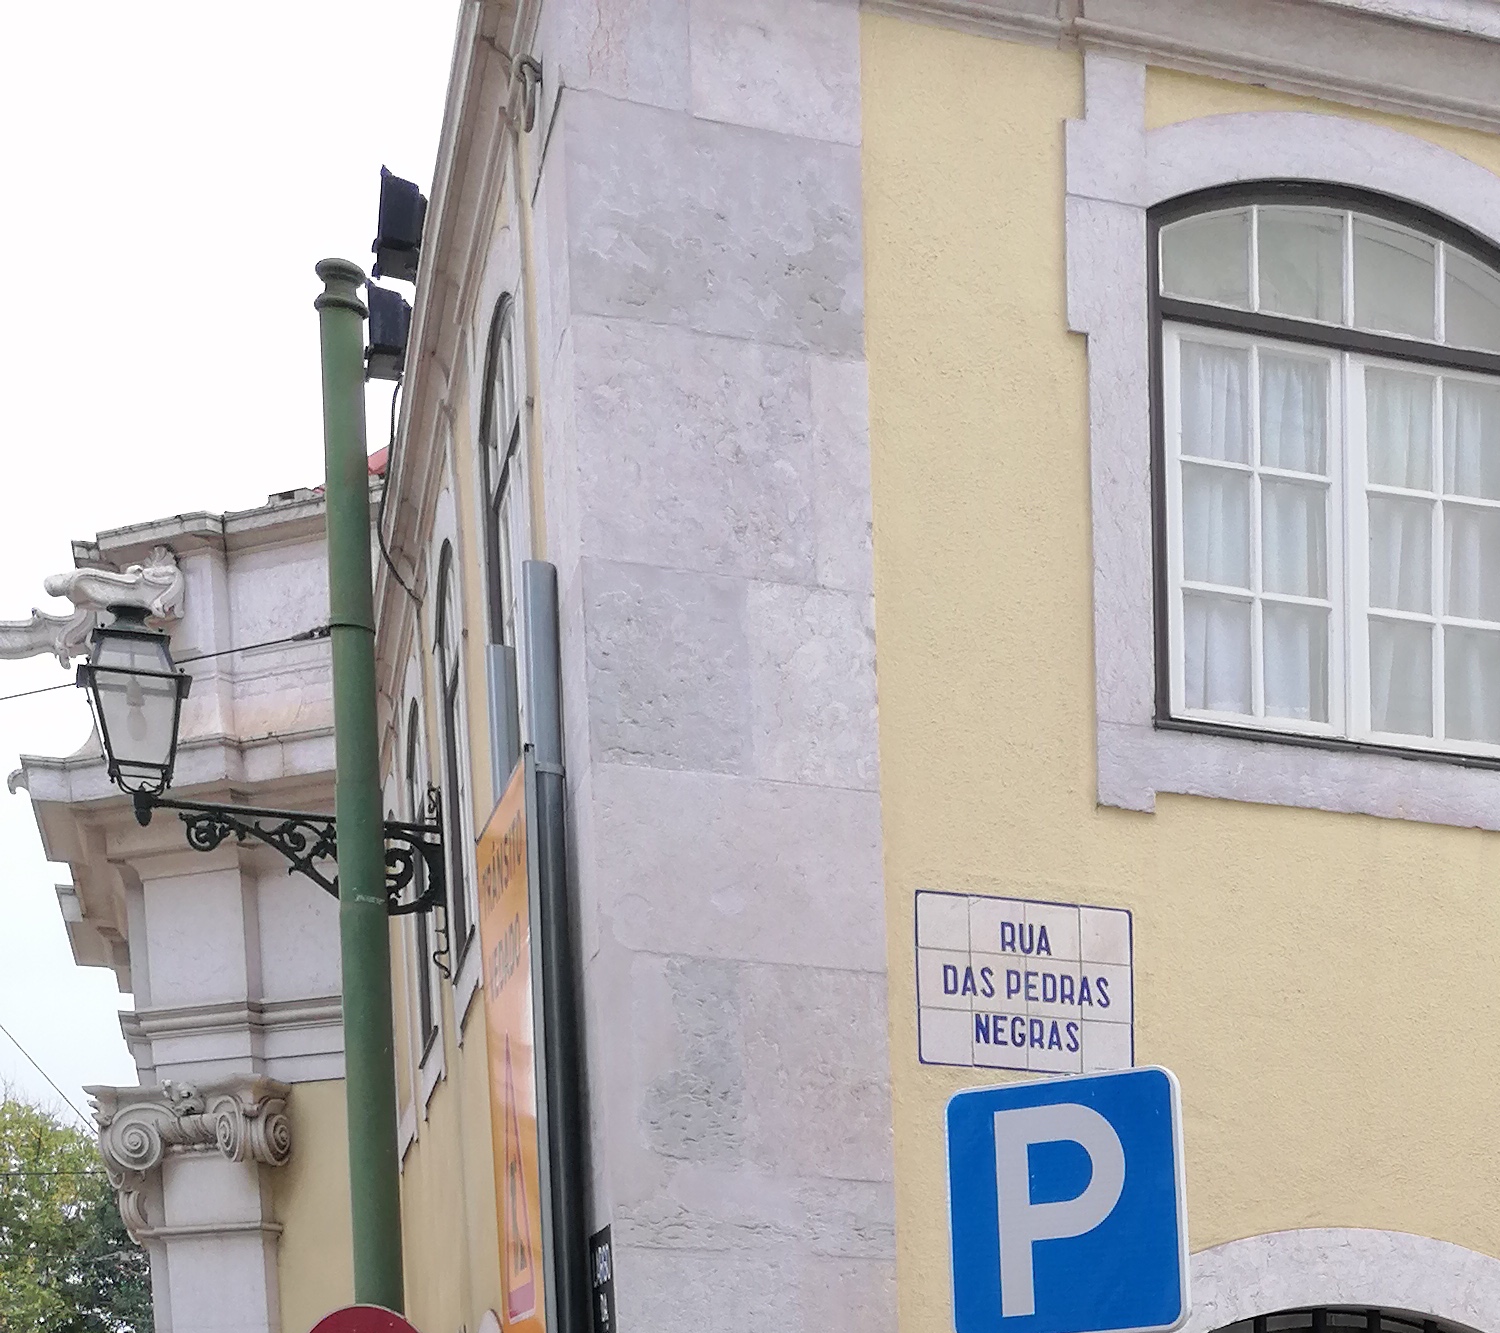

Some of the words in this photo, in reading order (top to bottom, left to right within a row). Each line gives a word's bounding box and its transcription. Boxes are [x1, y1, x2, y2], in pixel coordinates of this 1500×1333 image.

[1000, 921, 1052, 956] RUA
[942, 964, 995, 998] DAS
[1006, 968, 1110, 1008] PEDRAS
[975, 1013, 1080, 1053] NEGRAS
[994, 1103, 1126, 1318] P
